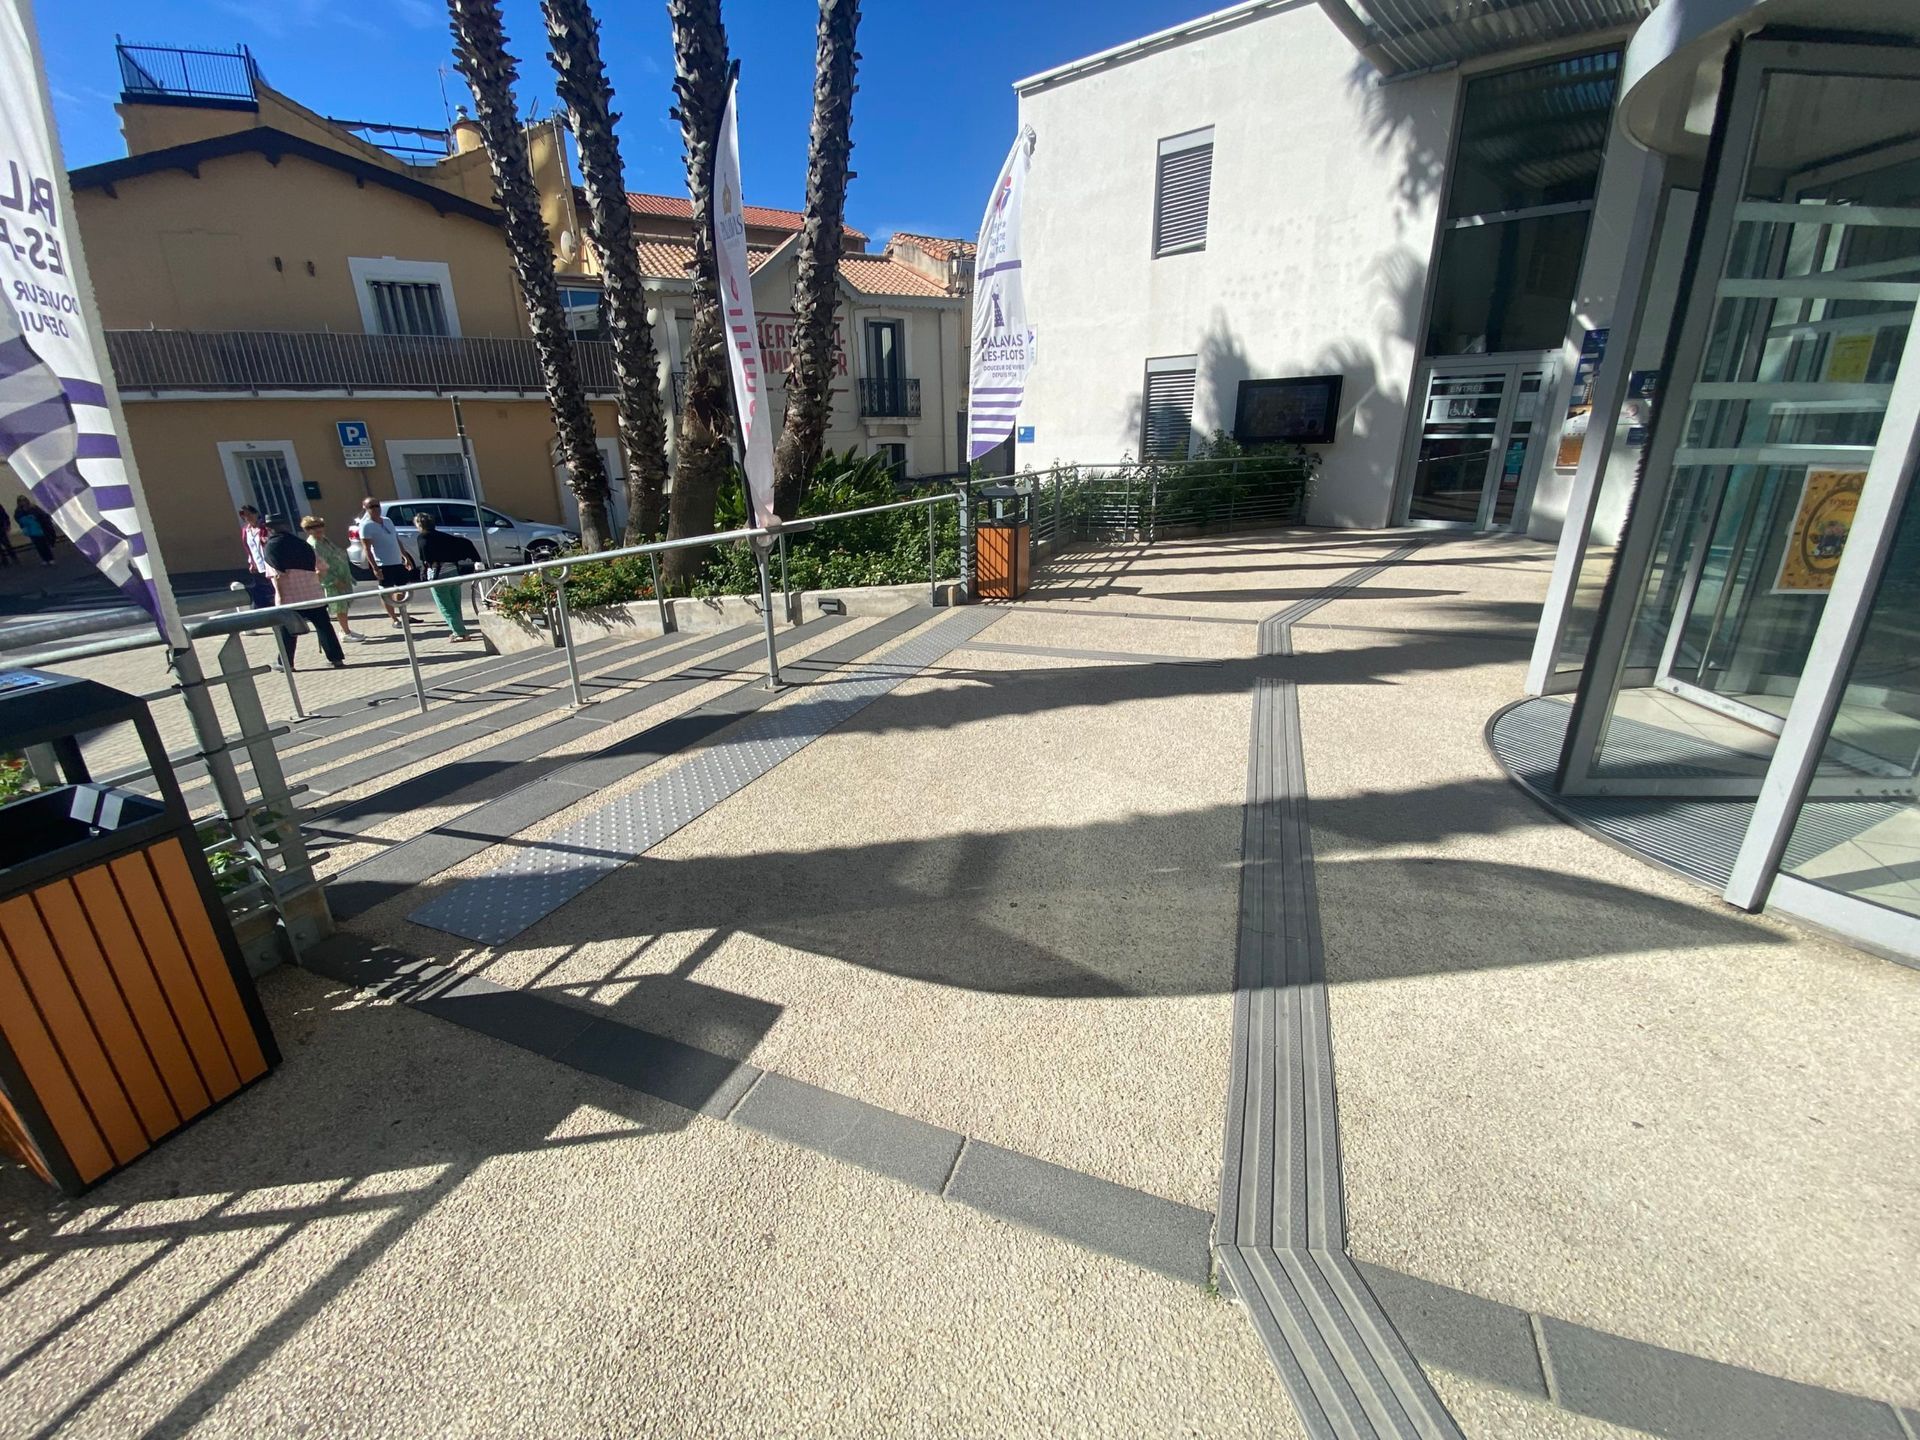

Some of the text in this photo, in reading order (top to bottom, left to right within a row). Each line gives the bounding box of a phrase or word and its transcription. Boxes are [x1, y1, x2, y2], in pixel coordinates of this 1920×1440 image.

[981, 334, 1023, 349] PALAVAS
[982, 349, 1024, 361] LES-FLOTS
[345, 426, 360, 442] P
